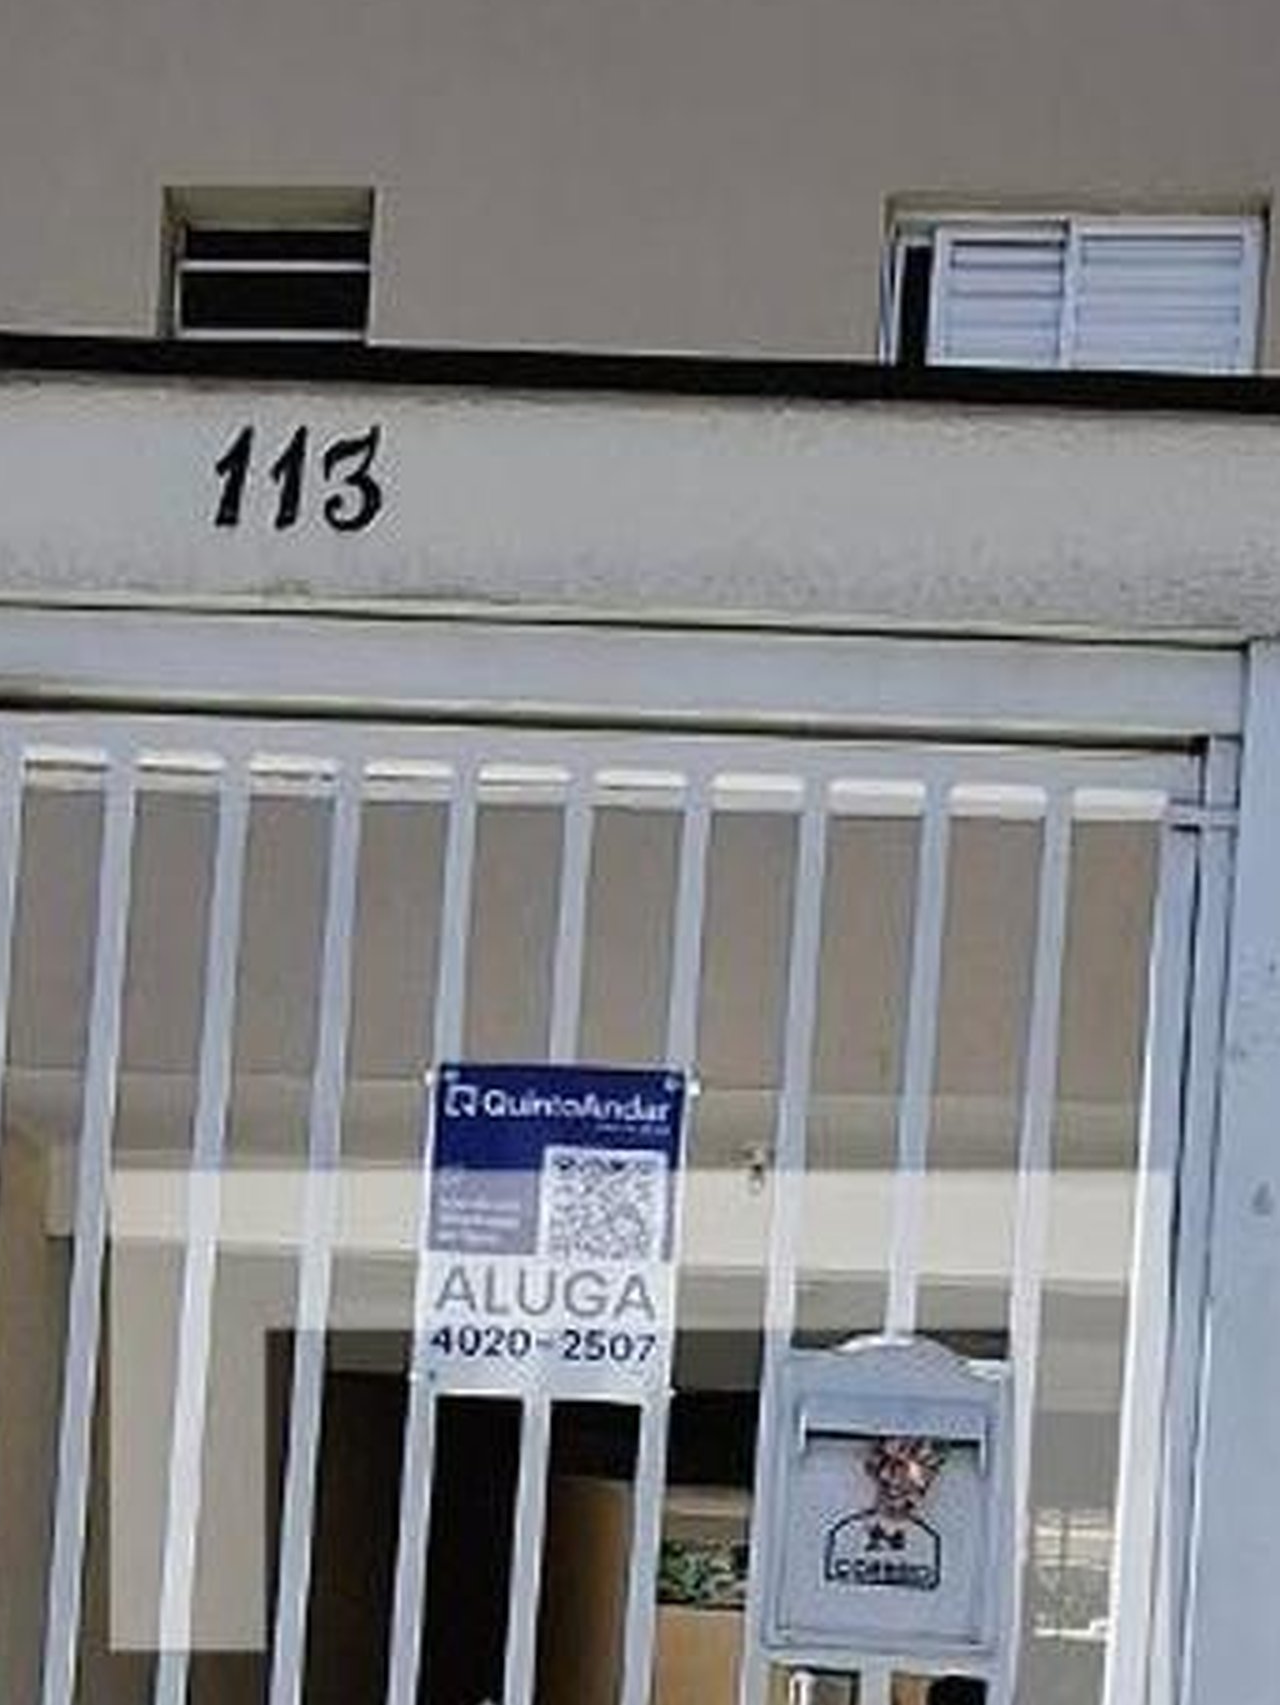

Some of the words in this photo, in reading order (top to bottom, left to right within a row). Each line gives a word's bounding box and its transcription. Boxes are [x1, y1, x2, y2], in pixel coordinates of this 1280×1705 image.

[215, 425, 382, 532] 113
[482, 1088, 672, 1122] QuintoAndar
[434, 1264, 657, 1321] ALUGA
[430, 1325, 657, 1362] 4020-2507
